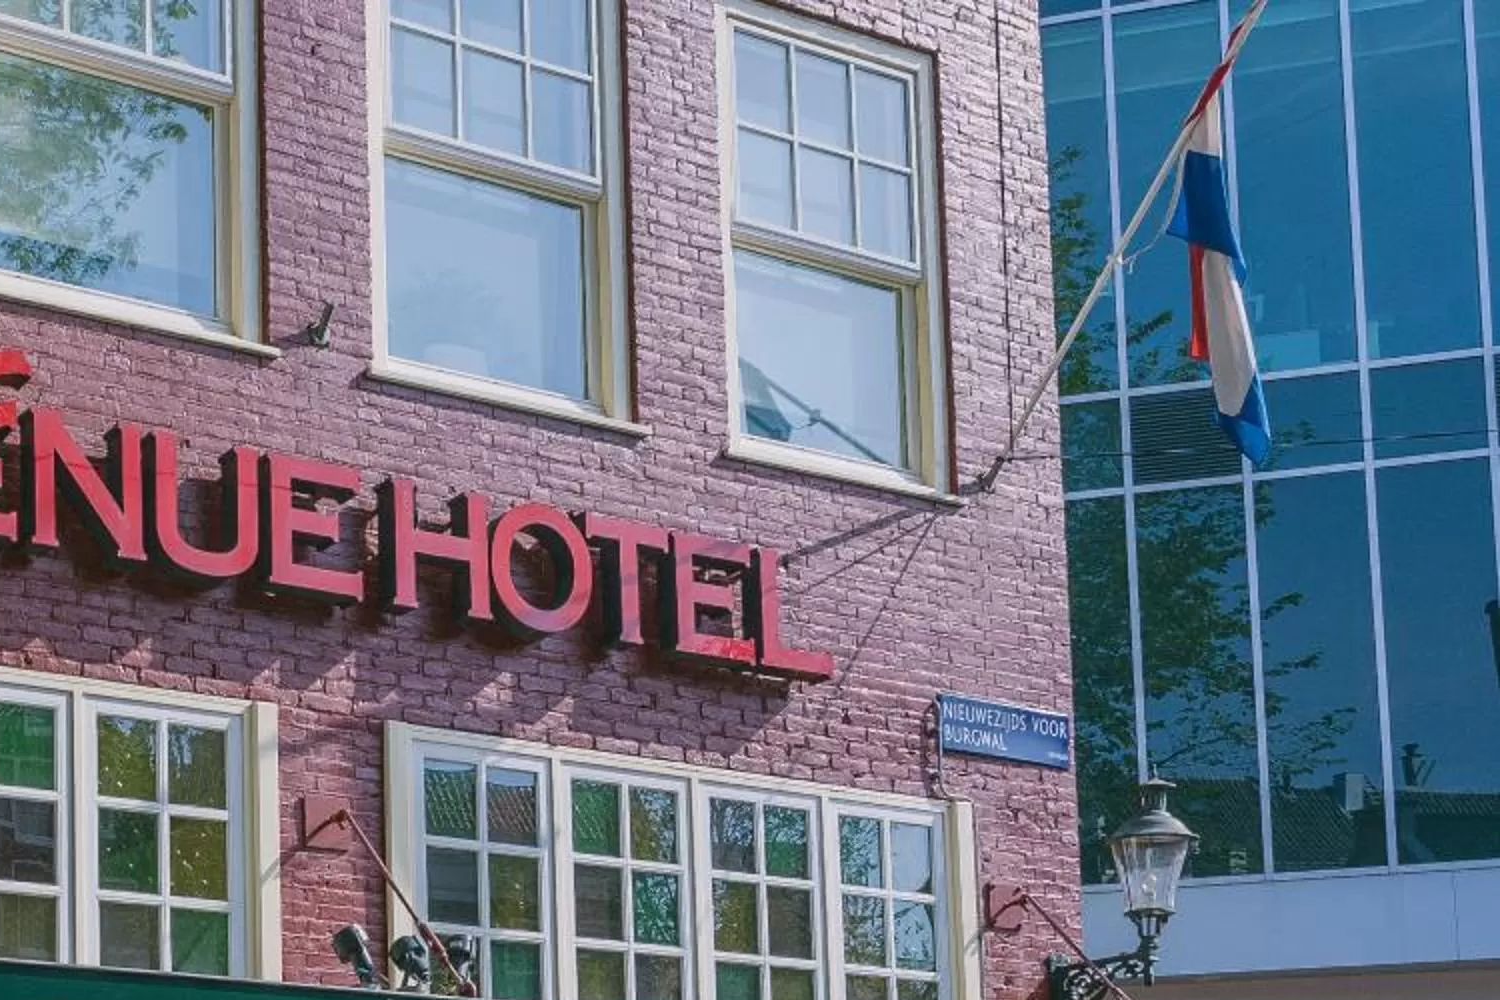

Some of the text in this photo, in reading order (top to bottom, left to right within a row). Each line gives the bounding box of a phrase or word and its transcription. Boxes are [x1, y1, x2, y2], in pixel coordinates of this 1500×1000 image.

[390, 477, 835, 680] HOTEL
[942, 701, 1068, 739] NIEUWEZIJDS VOOR
[943, 724, 1008, 751] BURGWAL
